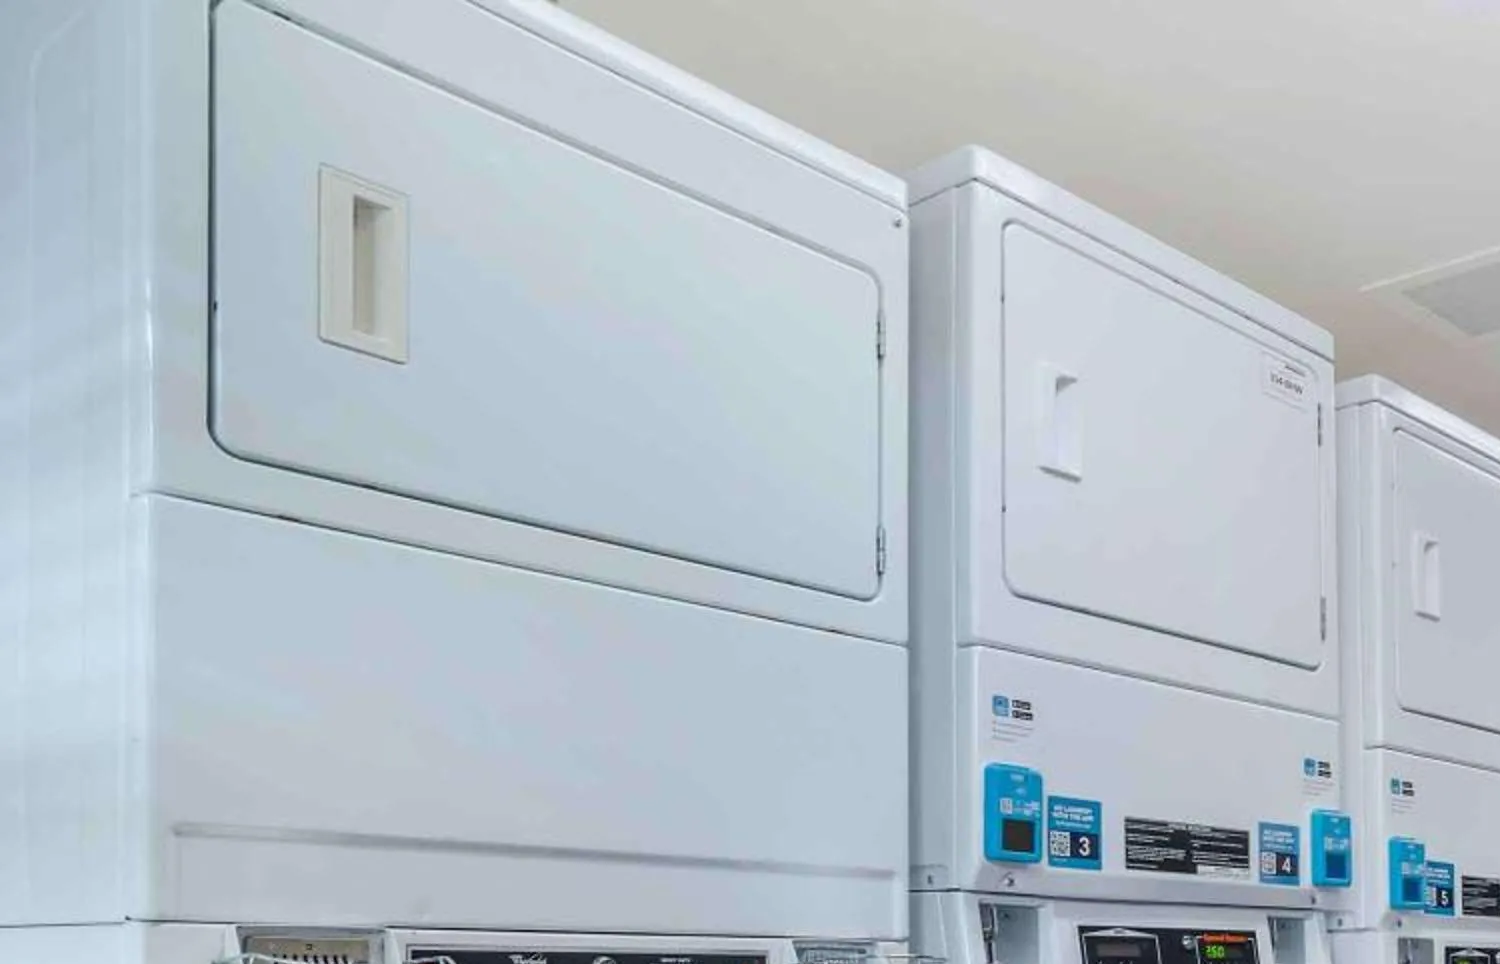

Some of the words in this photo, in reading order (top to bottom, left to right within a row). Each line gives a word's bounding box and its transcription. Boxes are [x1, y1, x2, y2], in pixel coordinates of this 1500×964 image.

[1079, 836, 1090, 857] 3
[1282, 857, 1291, 873] 4
[1441, 889, 1449, 906] 5
